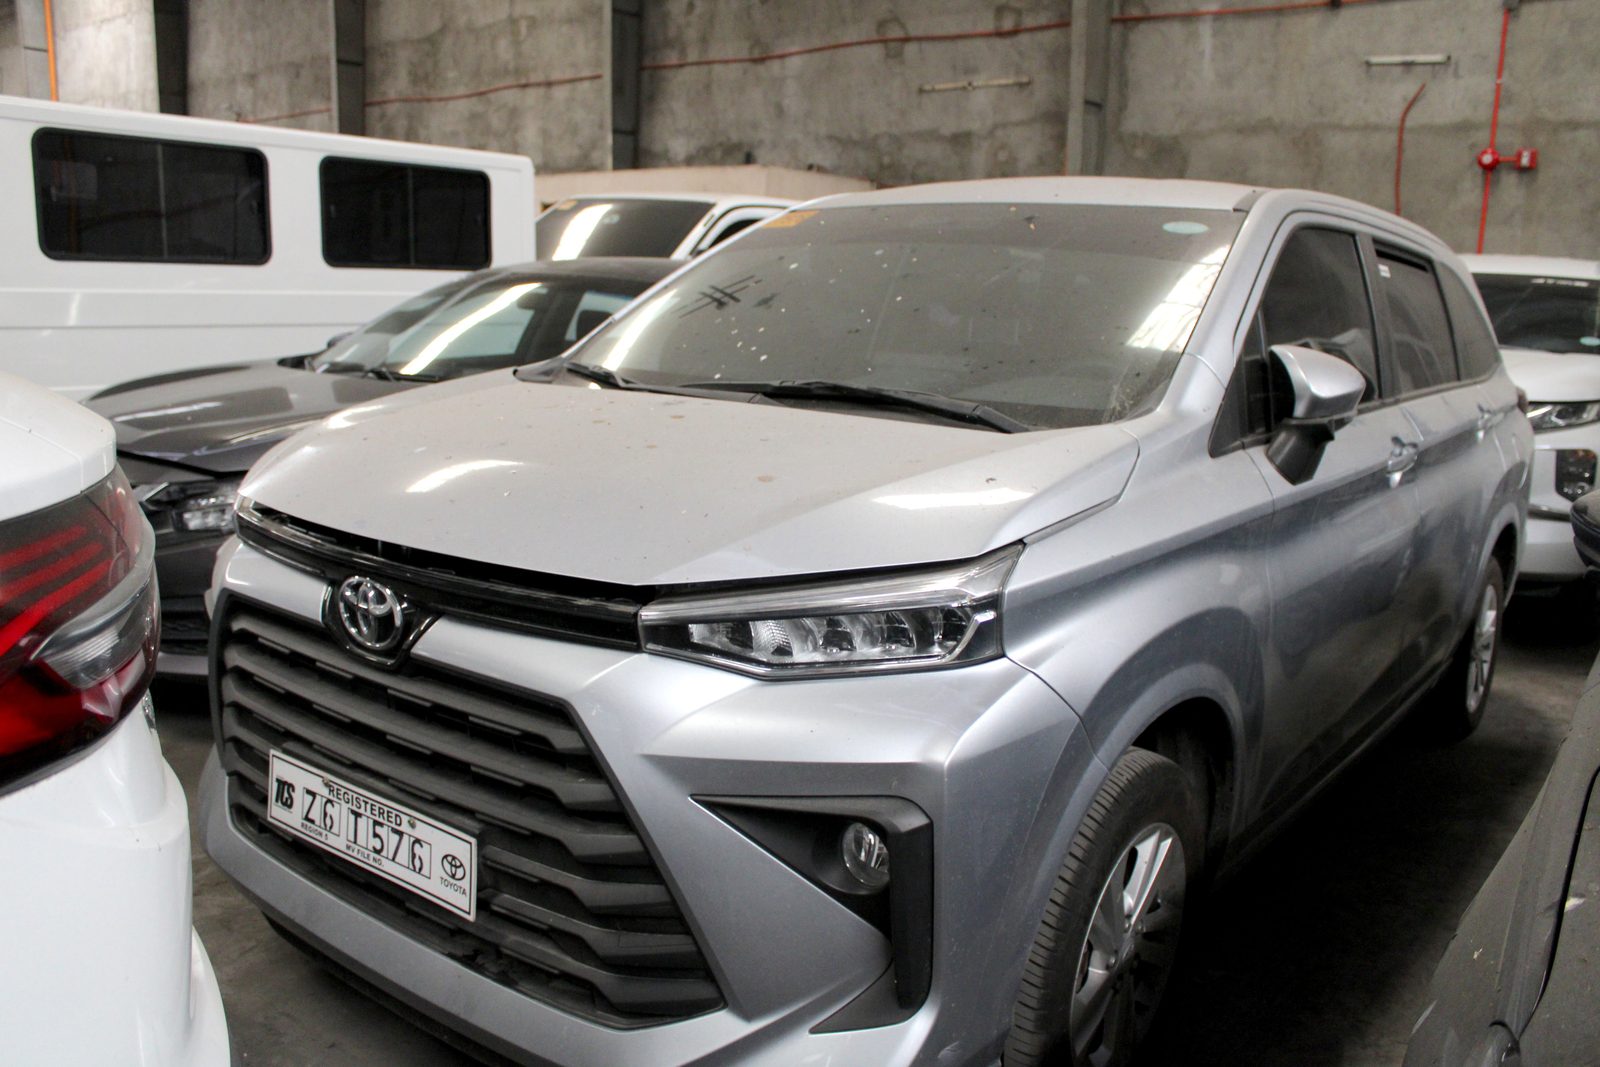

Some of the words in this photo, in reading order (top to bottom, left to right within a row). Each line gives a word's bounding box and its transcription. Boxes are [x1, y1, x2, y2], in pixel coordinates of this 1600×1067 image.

[328, 785, 402, 827] REGISTERED
[300, 822, 323, 838] REGION
[350, 810, 424, 875] T576
[346, 844, 356, 855] MV
[357, 848, 371, 862] FILE
[372, 856, 385, 867] NO.
[440, 876, 467, 897] TOYOTA
